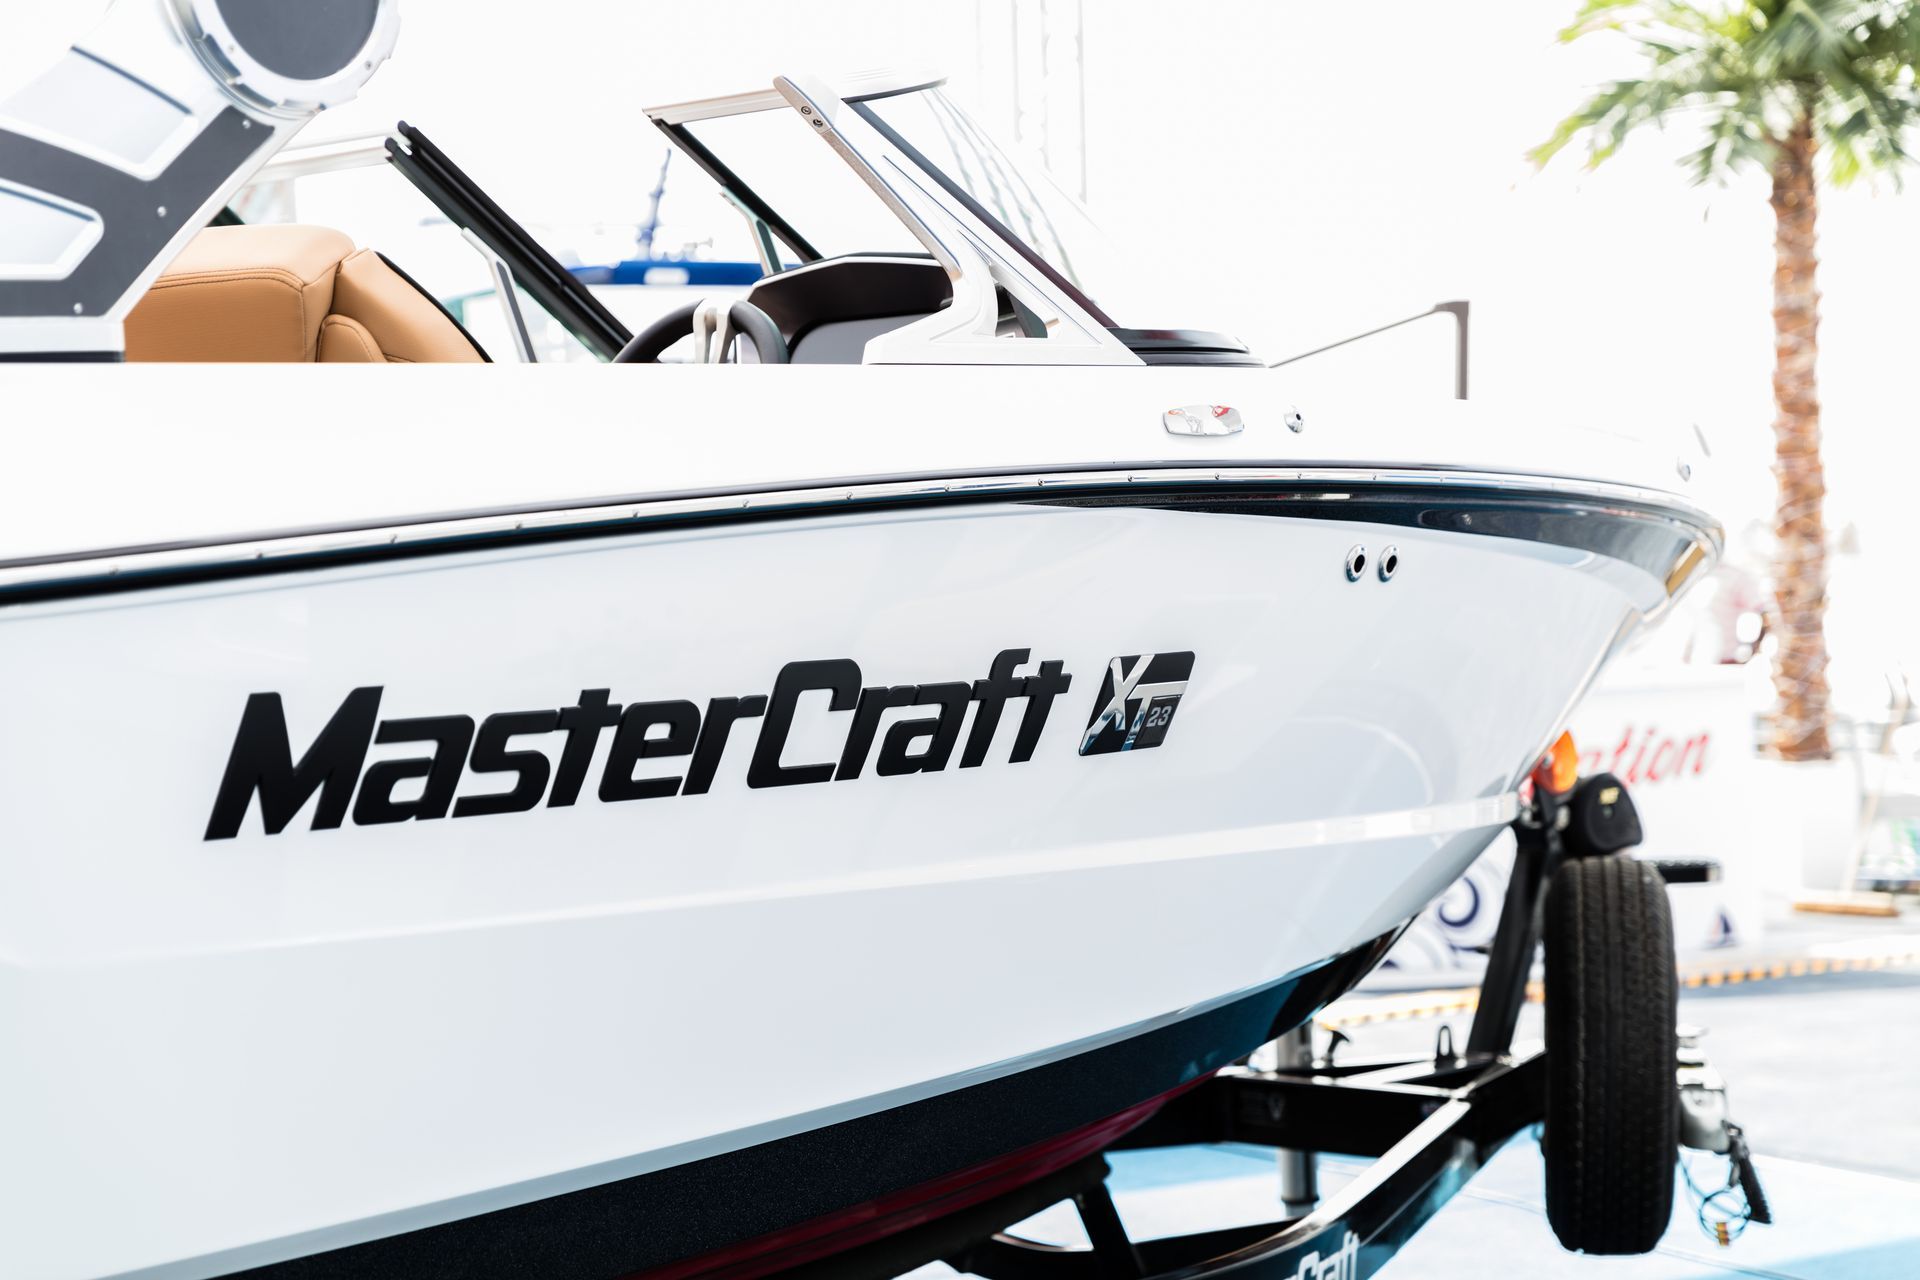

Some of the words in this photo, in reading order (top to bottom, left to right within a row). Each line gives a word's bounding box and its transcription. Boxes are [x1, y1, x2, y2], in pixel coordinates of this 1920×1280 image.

[204, 648, 1073, 840] MasterCraft
[1080, 654, 1188, 755] XT
[1146, 705, 1172, 727] 23
